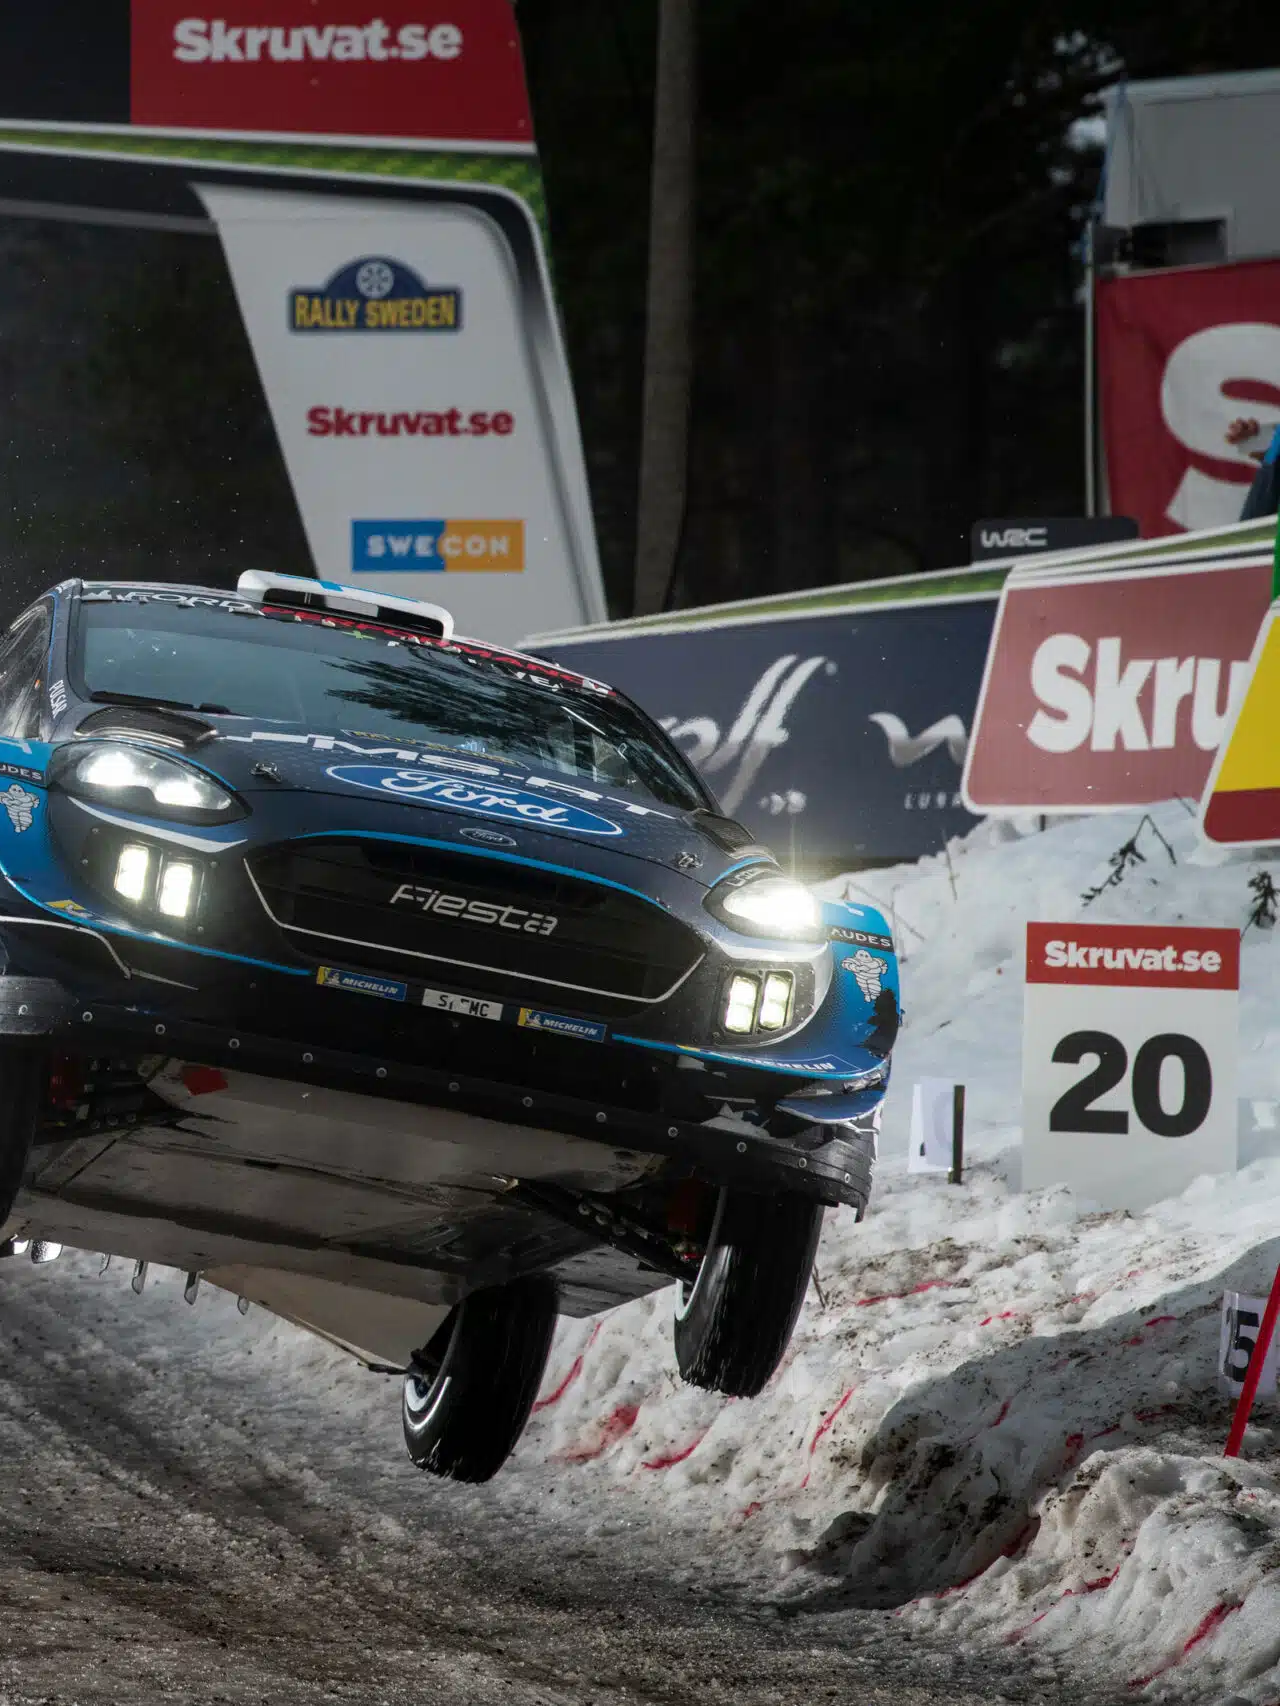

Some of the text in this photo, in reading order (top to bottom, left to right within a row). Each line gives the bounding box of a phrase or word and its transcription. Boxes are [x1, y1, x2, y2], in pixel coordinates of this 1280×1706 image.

[173, 18, 462, 62] Skruvat.se
[295, 295, 455, 327] RALLY SWEDEN
[307, 405, 514, 436] Skruvat.se
[367, 534, 509, 557] SWECON
[981, 527, 1048, 548] WRC
[124, 591, 253, 610] FORD
[48, 679, 68, 719] PULSAR
[657, 654, 826, 817] olf
[381, 770, 569, 823] Ford
[389, 884, 559, 936] Fiesta
[831, 926, 891, 948] AUDES
[1044, 940, 1222, 973] Skruvat.se
[342, 976, 399, 994] MICHELIN
[543, 1018, 598, 1036] MICHELIN
[1049, 1030, 1213, 1138] 20
